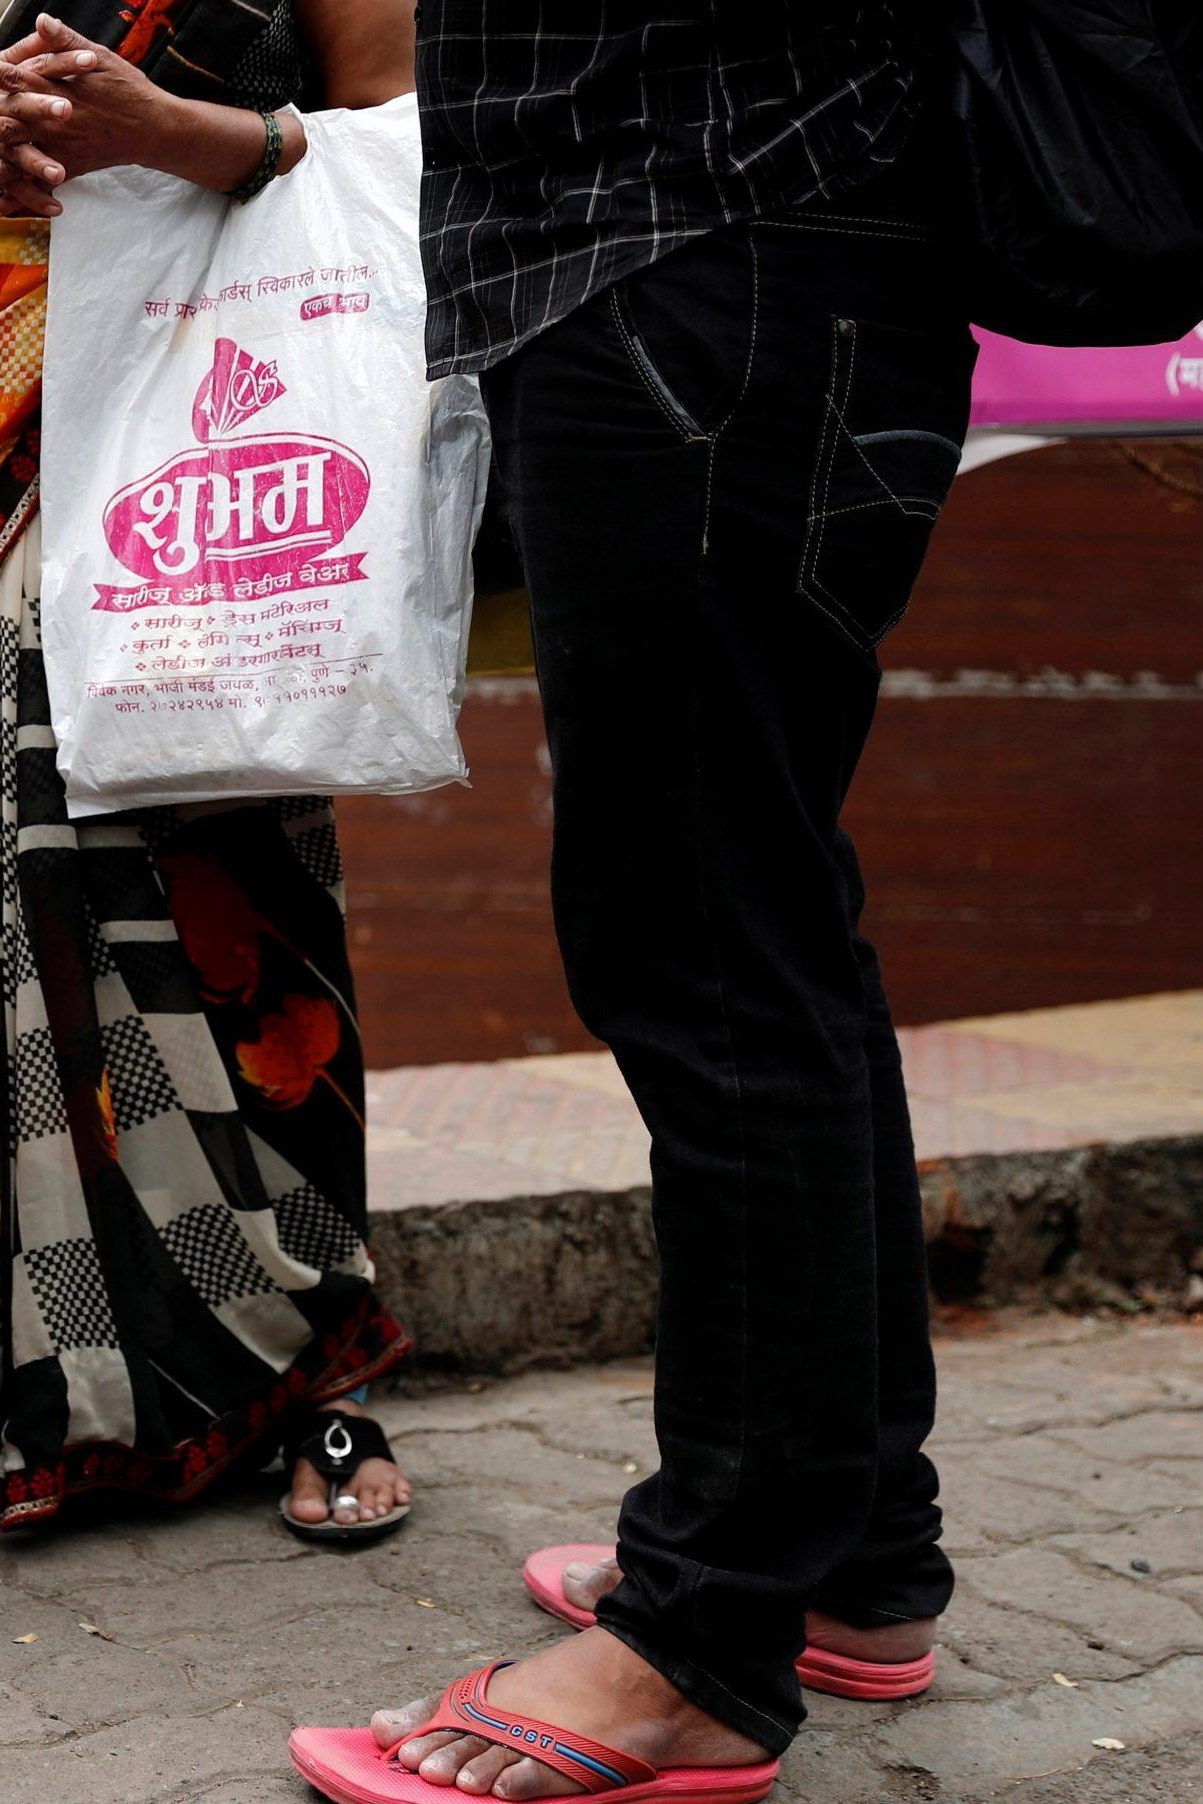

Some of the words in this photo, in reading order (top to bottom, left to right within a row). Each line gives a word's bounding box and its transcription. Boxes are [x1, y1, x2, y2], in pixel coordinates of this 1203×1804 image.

[144, 297, 170, 317] सर्व
[132, 452, 332, 576] शुभम
[233, 571, 294, 598] लेडीज
[298, 562, 350, 583] वेअर
[260, 598, 331, 621] मटेरिअल
[153, 679, 184, 694] भाजी
[188, 677, 216, 693] मंडई
[310, 663, 330, 684] पुणे
[510, 1725, 553, 1748] GST
